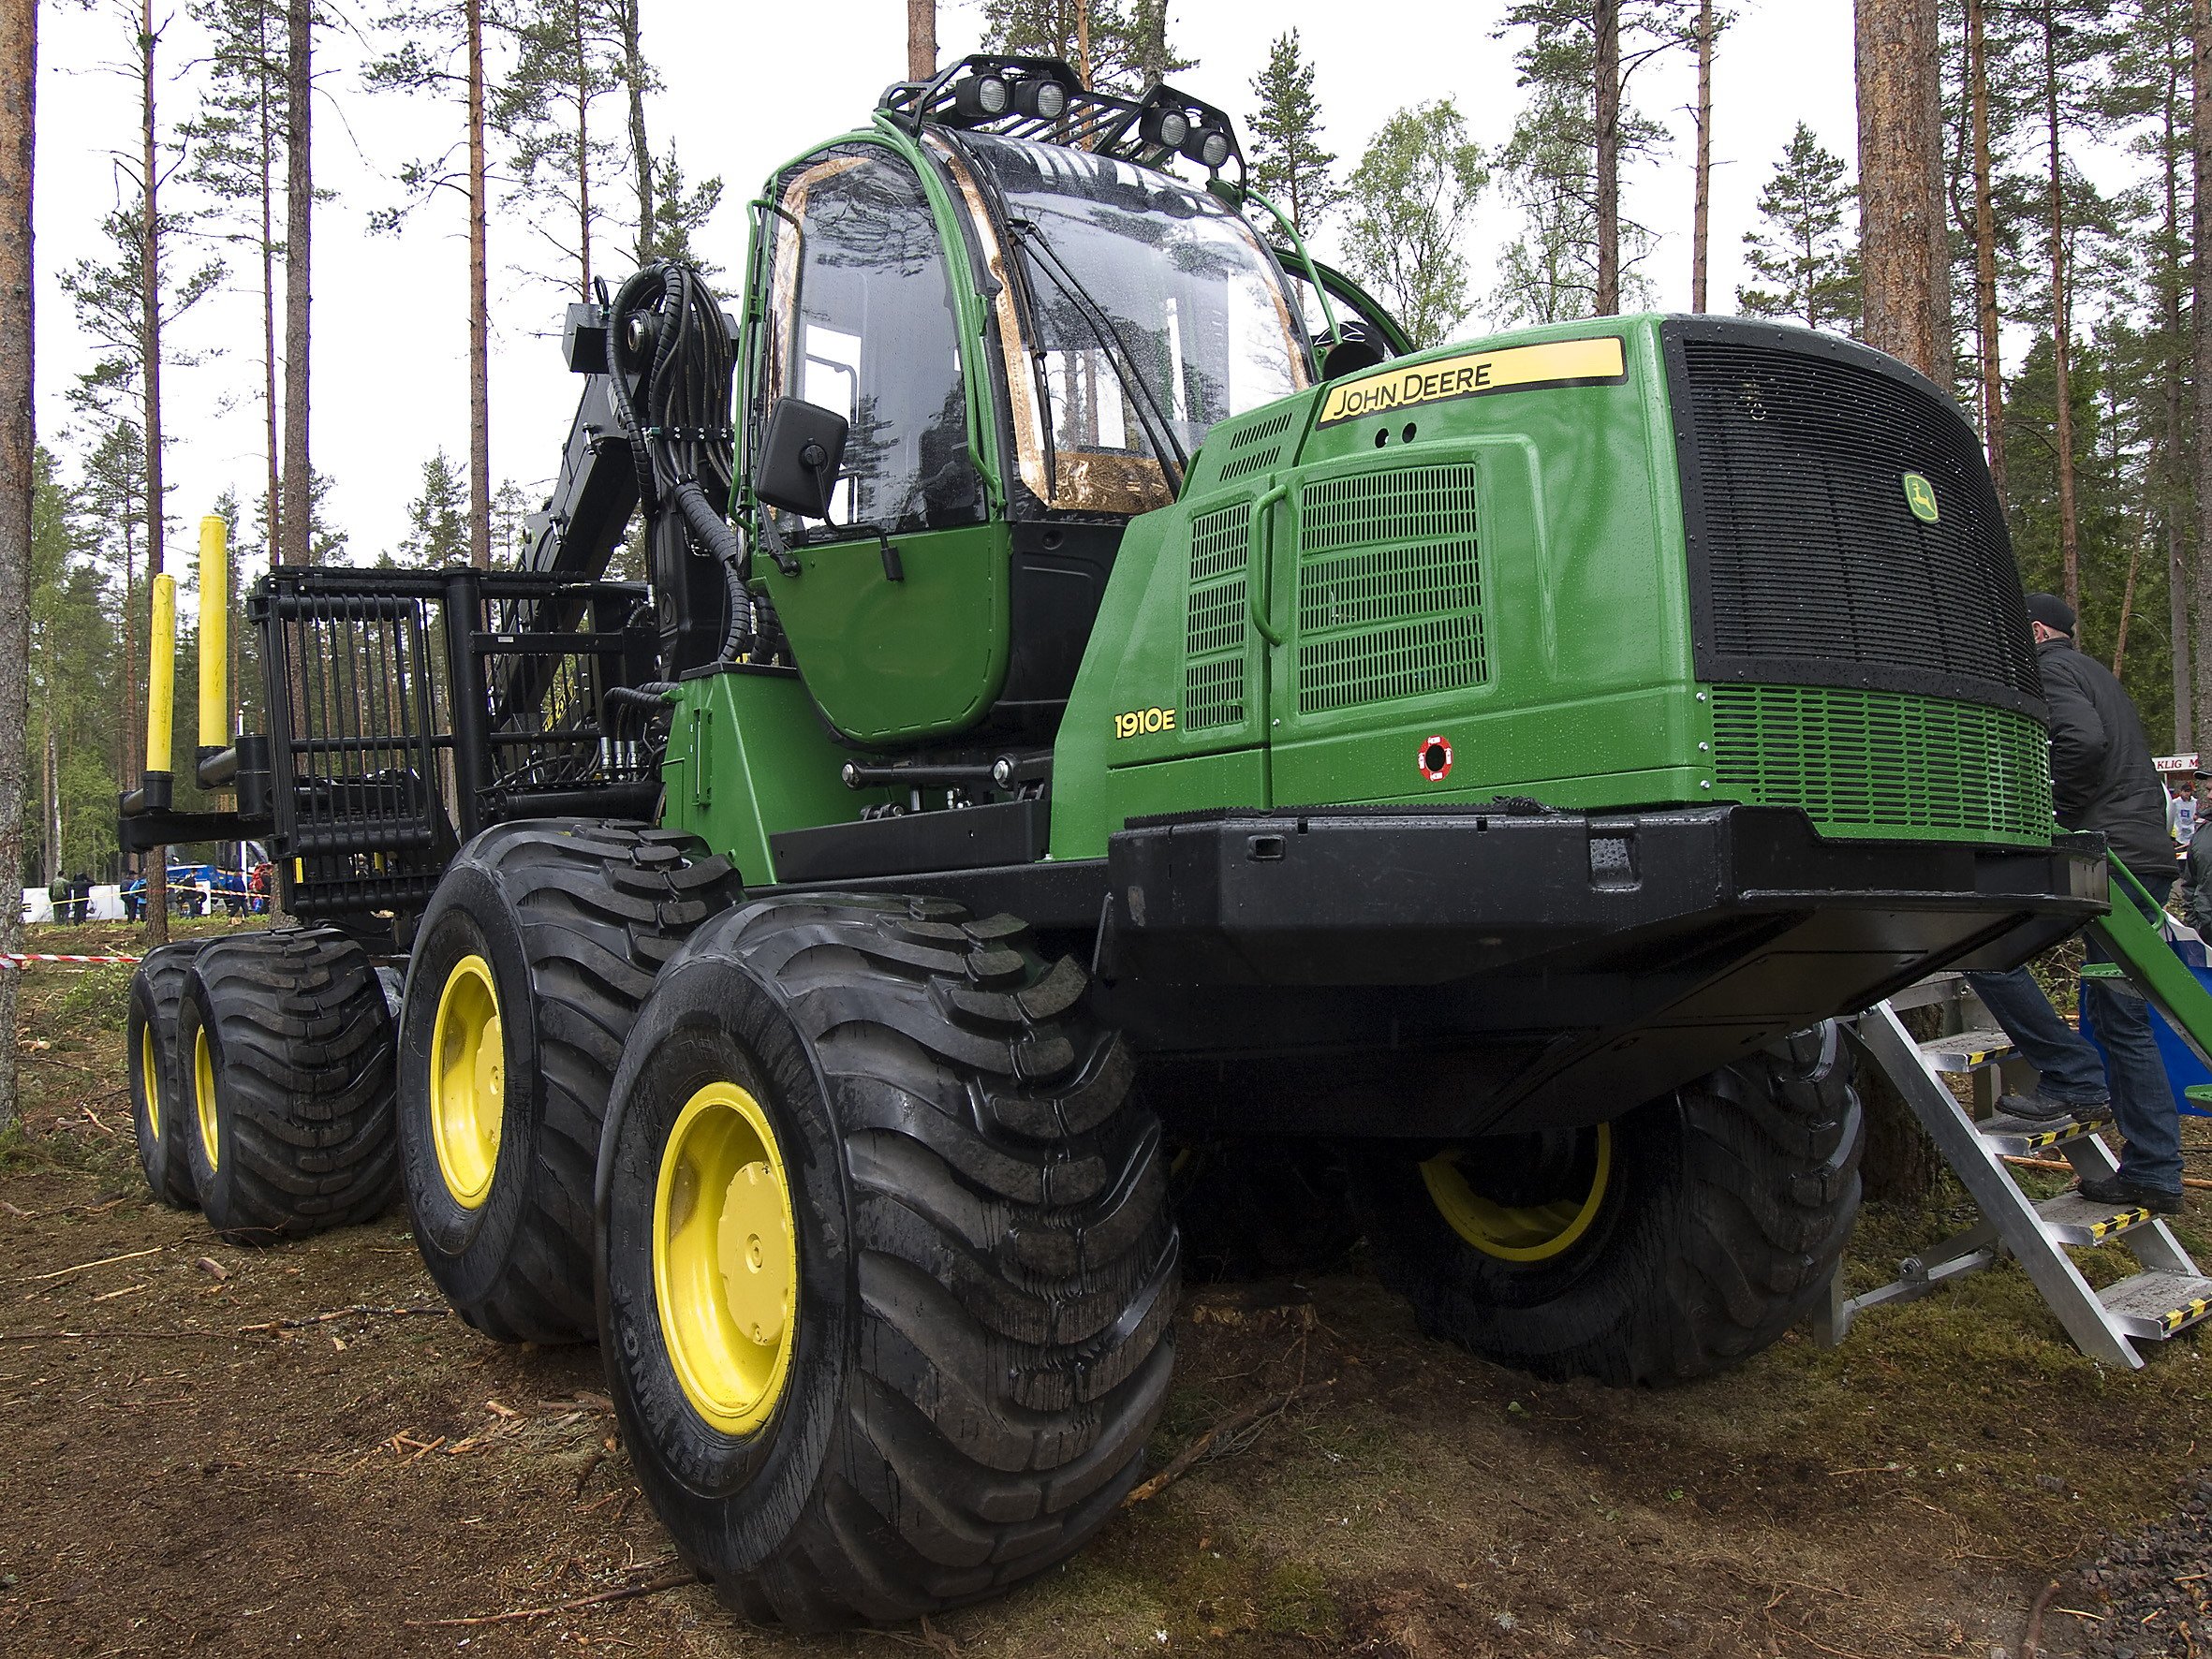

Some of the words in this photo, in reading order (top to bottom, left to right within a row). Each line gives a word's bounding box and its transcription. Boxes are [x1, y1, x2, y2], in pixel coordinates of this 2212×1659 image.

[1334, 385, 1397, 417] JOHN
[1403, 363, 1492, 401] DEERE
[1114, 707, 1176, 740] 1910E
